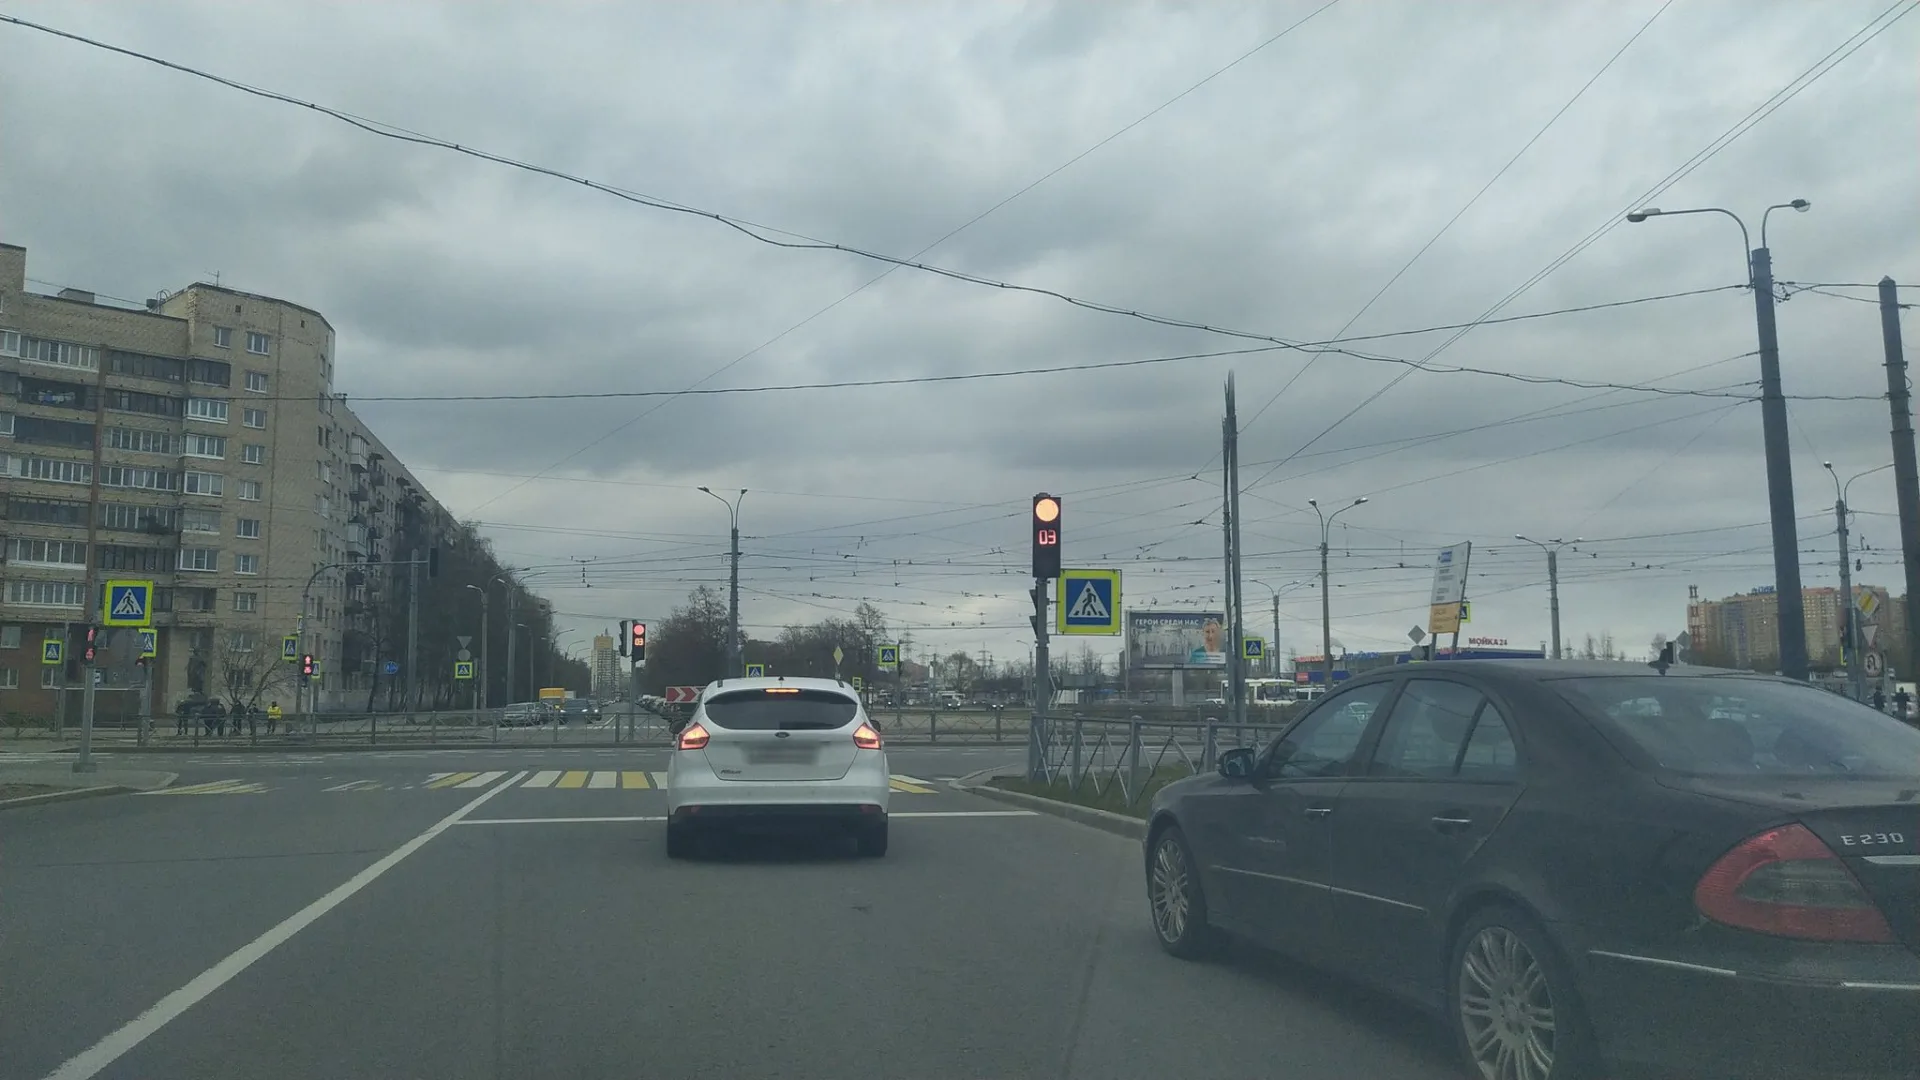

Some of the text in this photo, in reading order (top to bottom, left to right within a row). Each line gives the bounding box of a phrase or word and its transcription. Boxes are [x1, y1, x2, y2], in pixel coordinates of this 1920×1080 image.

[1039, 529, 1056, 545] 03
[1135, 618, 1199, 626] ГЕРОИ СРЕДИ НАС
